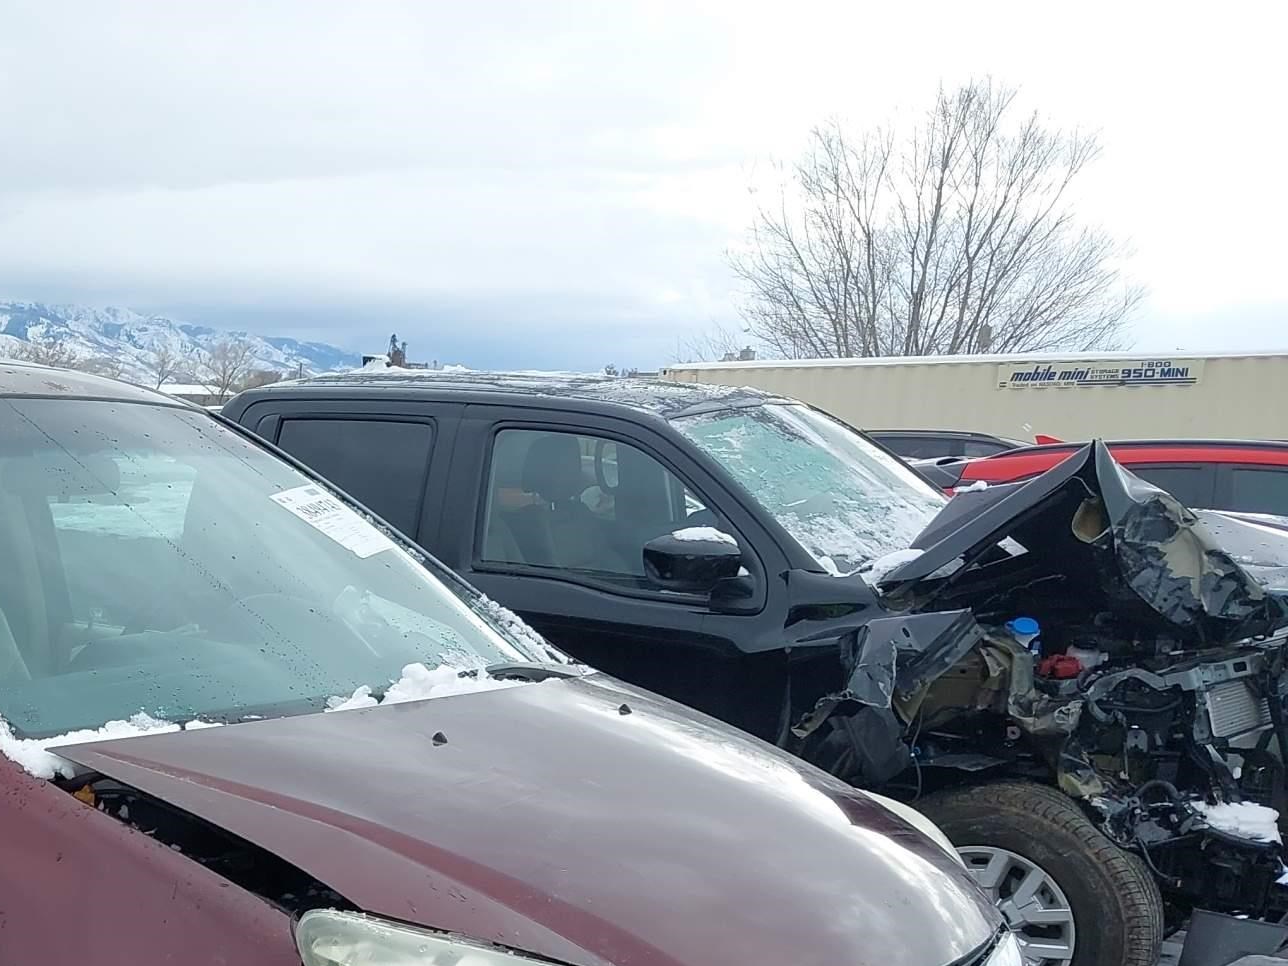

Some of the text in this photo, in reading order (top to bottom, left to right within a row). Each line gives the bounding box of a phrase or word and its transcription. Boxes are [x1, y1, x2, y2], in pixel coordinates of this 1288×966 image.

[1010, 365, 1091, 382] mobile mini
[1121, 367, 1189, 379] 950-MINI
